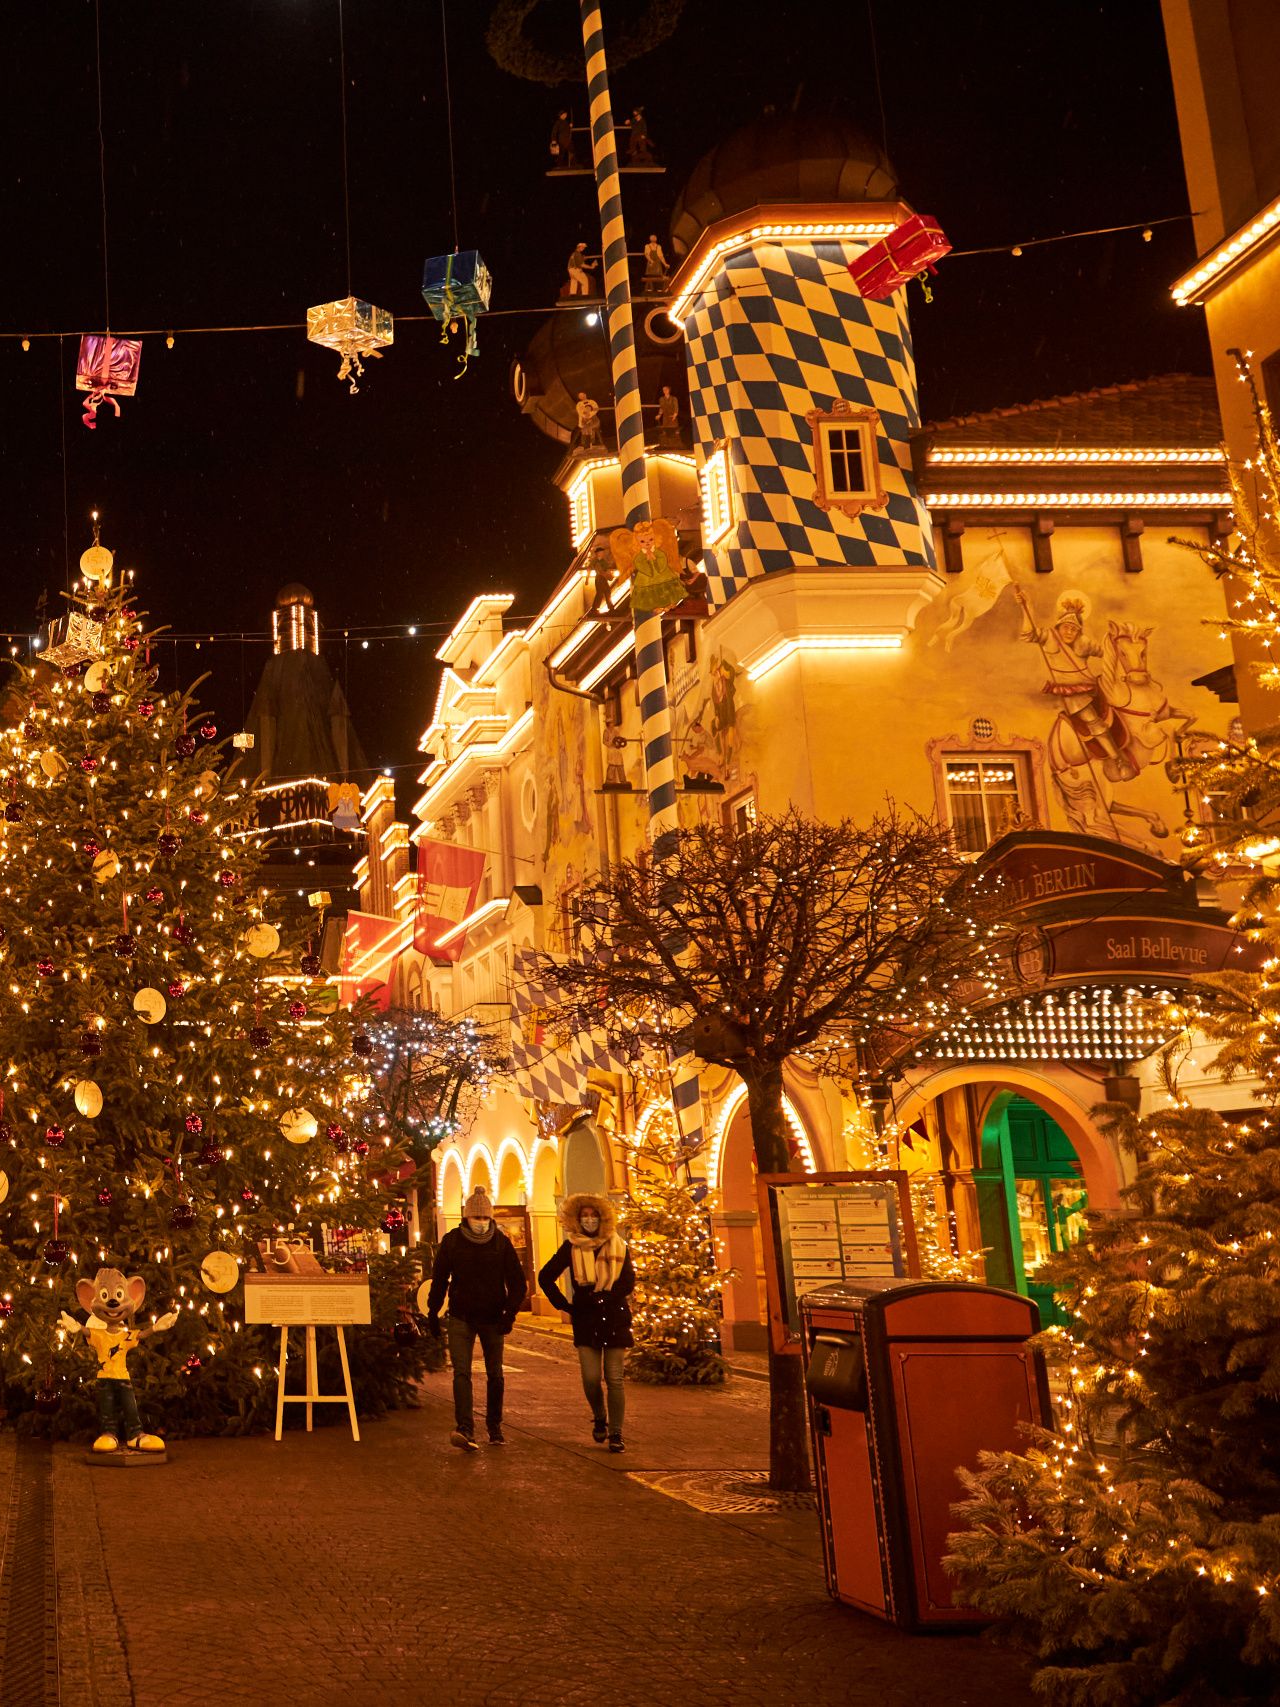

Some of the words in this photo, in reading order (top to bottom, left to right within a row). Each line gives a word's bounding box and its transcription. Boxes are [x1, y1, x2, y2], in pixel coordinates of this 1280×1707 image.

[1033, 863, 1095, 897] BERLIN
[1107, 937, 1135, 960] Saal
[1141, 937, 1207, 964] Bellevue
[262, 1237, 318, 1265] 1521
